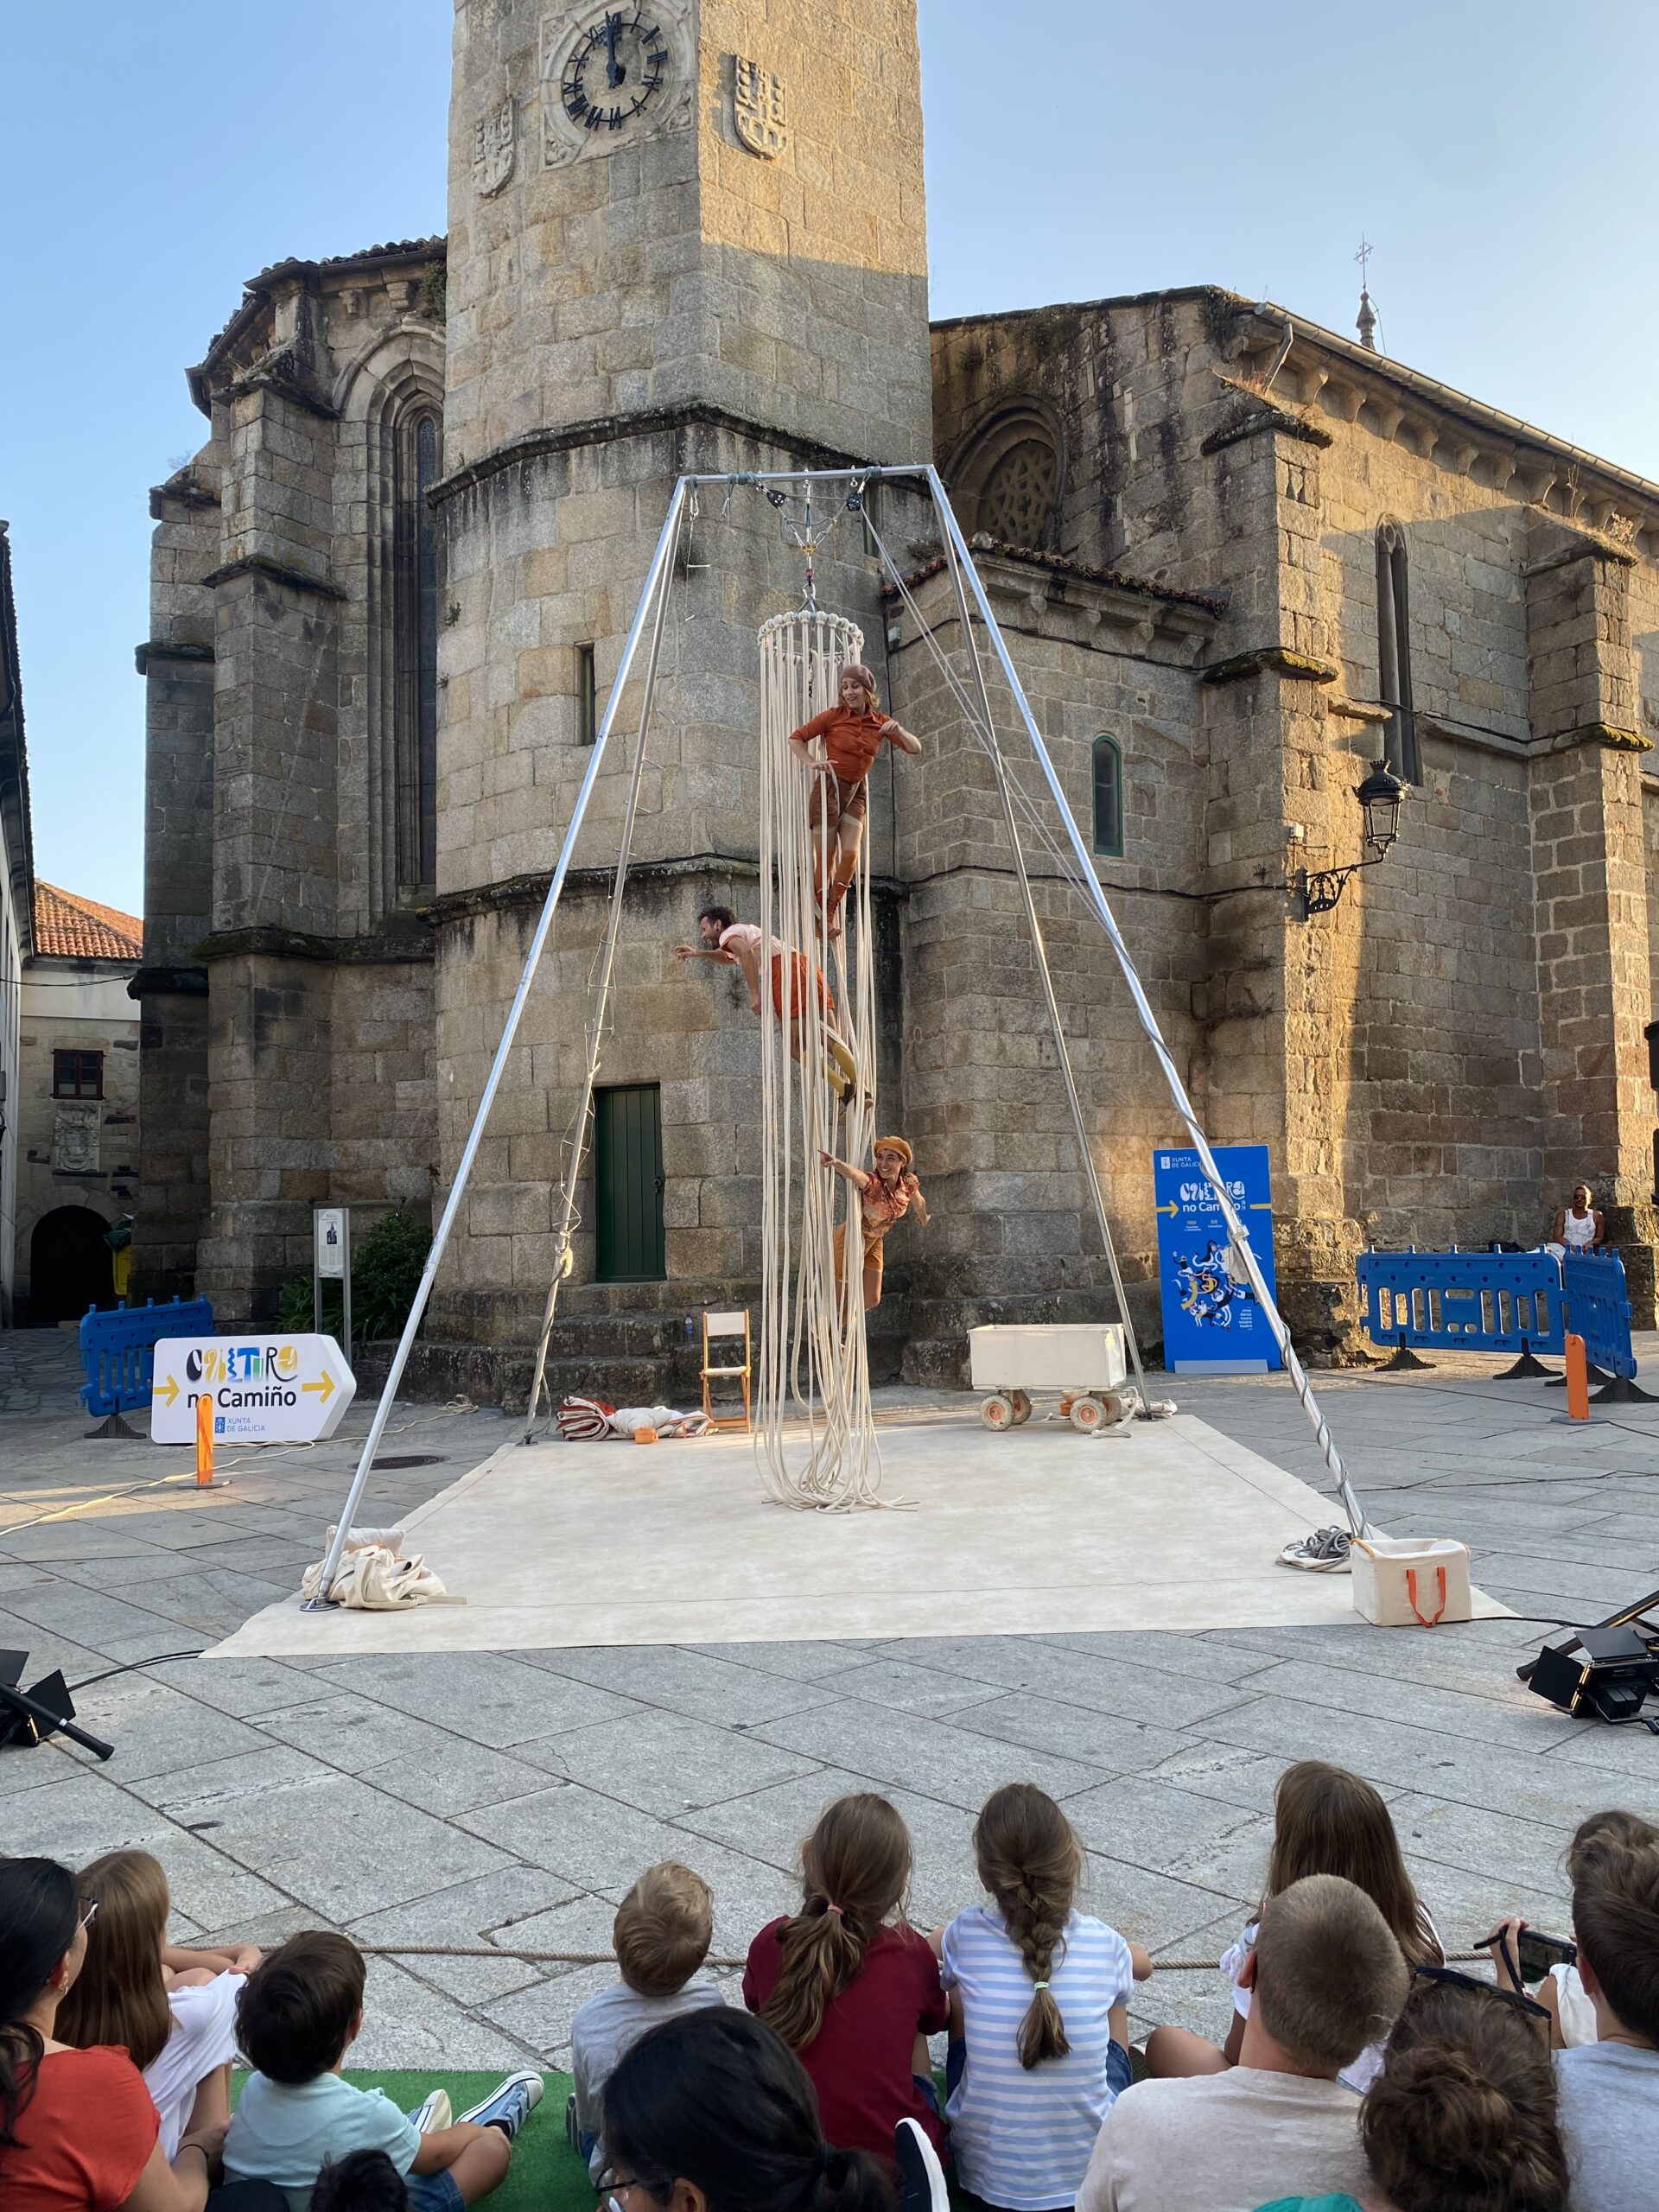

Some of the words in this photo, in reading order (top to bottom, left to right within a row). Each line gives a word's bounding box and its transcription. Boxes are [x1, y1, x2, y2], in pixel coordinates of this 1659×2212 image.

[646, 49, 668, 65] III
[1182, 1204, 1197, 1212] no
[217, 1385, 297, 1408] Camiño
[238, 1424, 265, 1433] GALICIA
